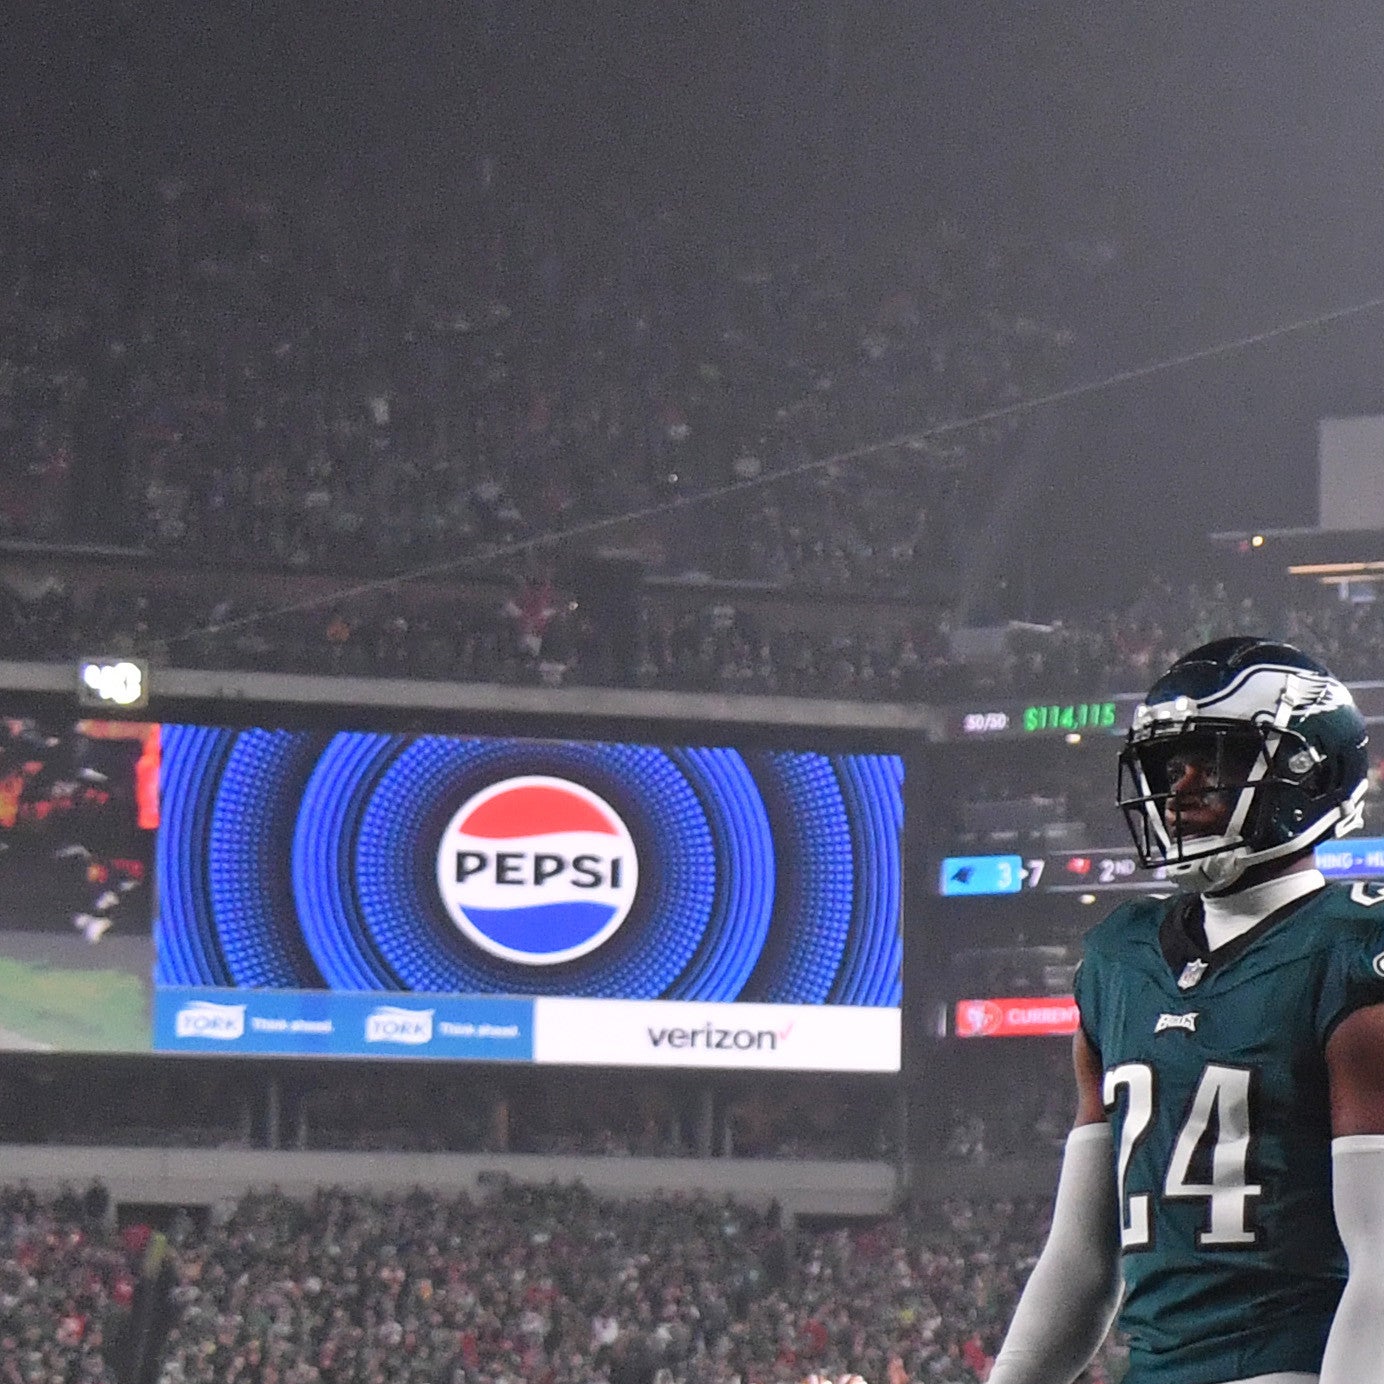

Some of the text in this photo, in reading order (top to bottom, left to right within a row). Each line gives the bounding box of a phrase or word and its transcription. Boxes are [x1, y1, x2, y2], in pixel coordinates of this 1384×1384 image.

[1022, 702, 1117, 733] $114,115
[455, 850, 623, 890] PEPSI
[1026, 858, 1046, 888] 7
[647, 1021, 777, 1051] verizon
[1102, 1062, 1262, 1248] 24
